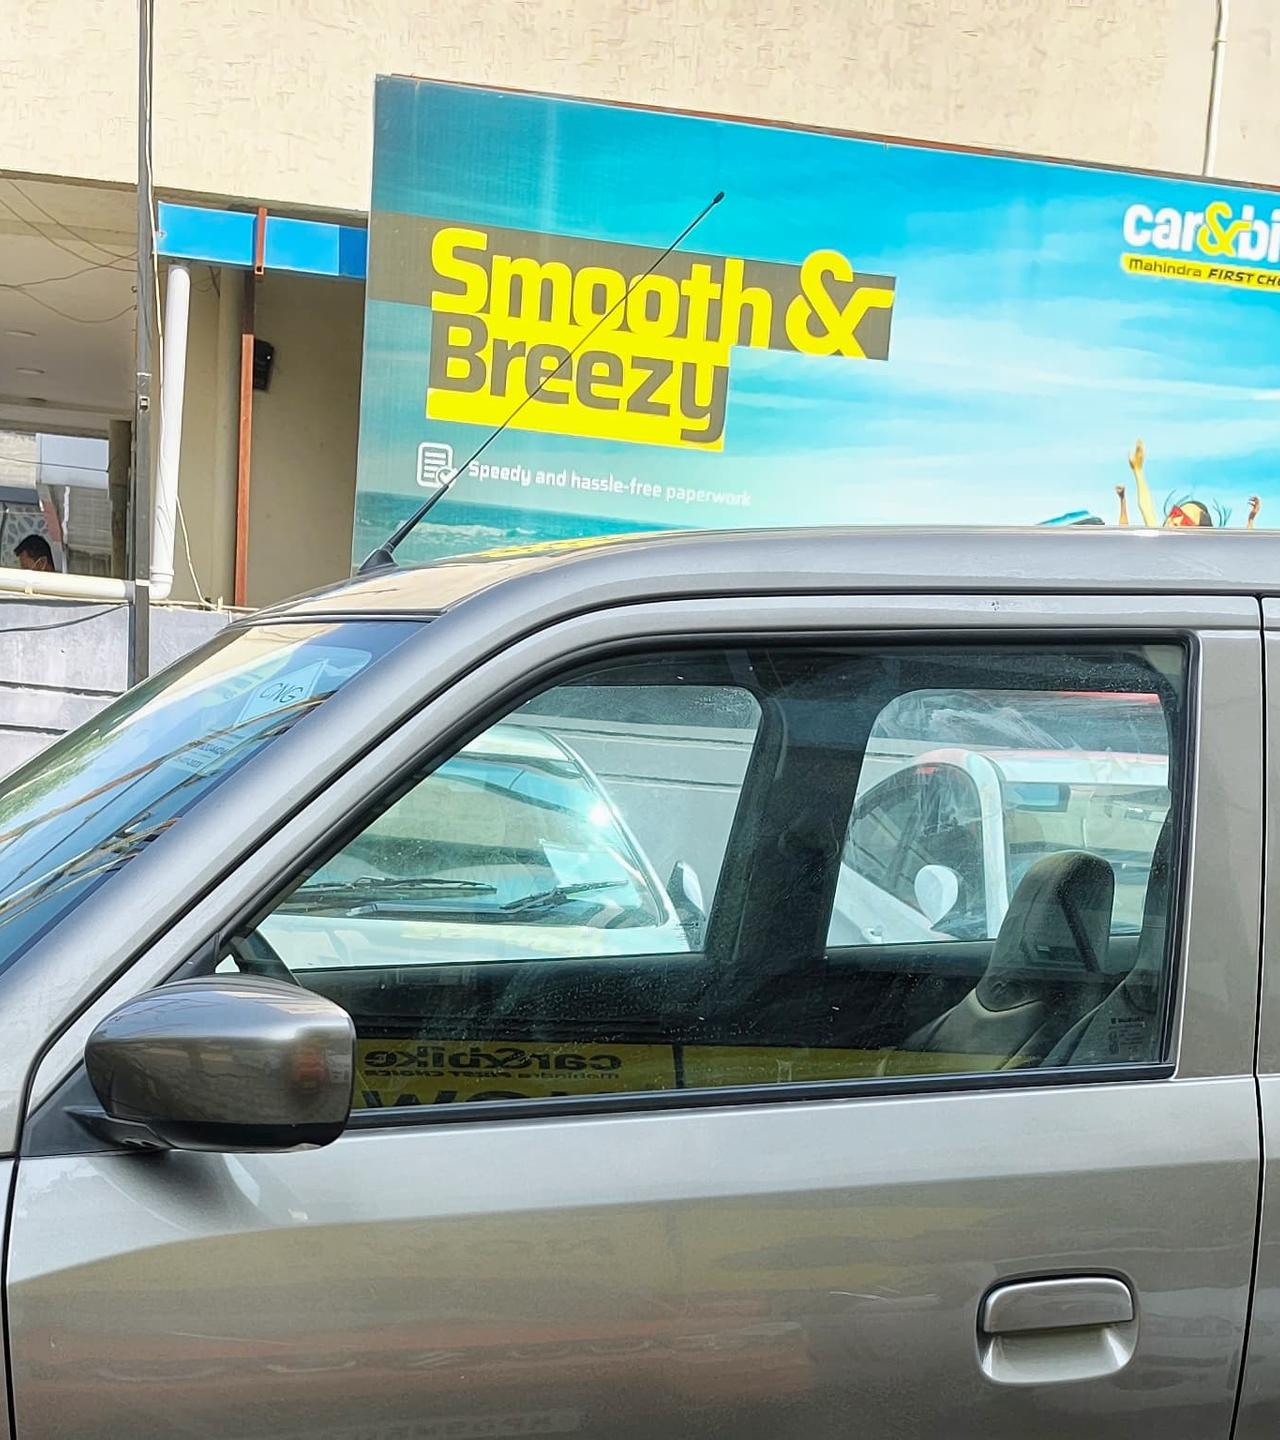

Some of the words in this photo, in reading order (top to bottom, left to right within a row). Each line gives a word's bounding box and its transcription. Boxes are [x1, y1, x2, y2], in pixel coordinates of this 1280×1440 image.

[431, 227, 773, 348] Smooth
[785, 249, 895, 358] &
[1207, 268, 1254, 283] FIRST
[428, 312, 729, 443] Breezy
[469, 460, 531, 487] Speedy
[535, 469, 568, 488] and
[571, 472, 662, 499] hassle-free
[666, 485, 752, 507] paperwork
